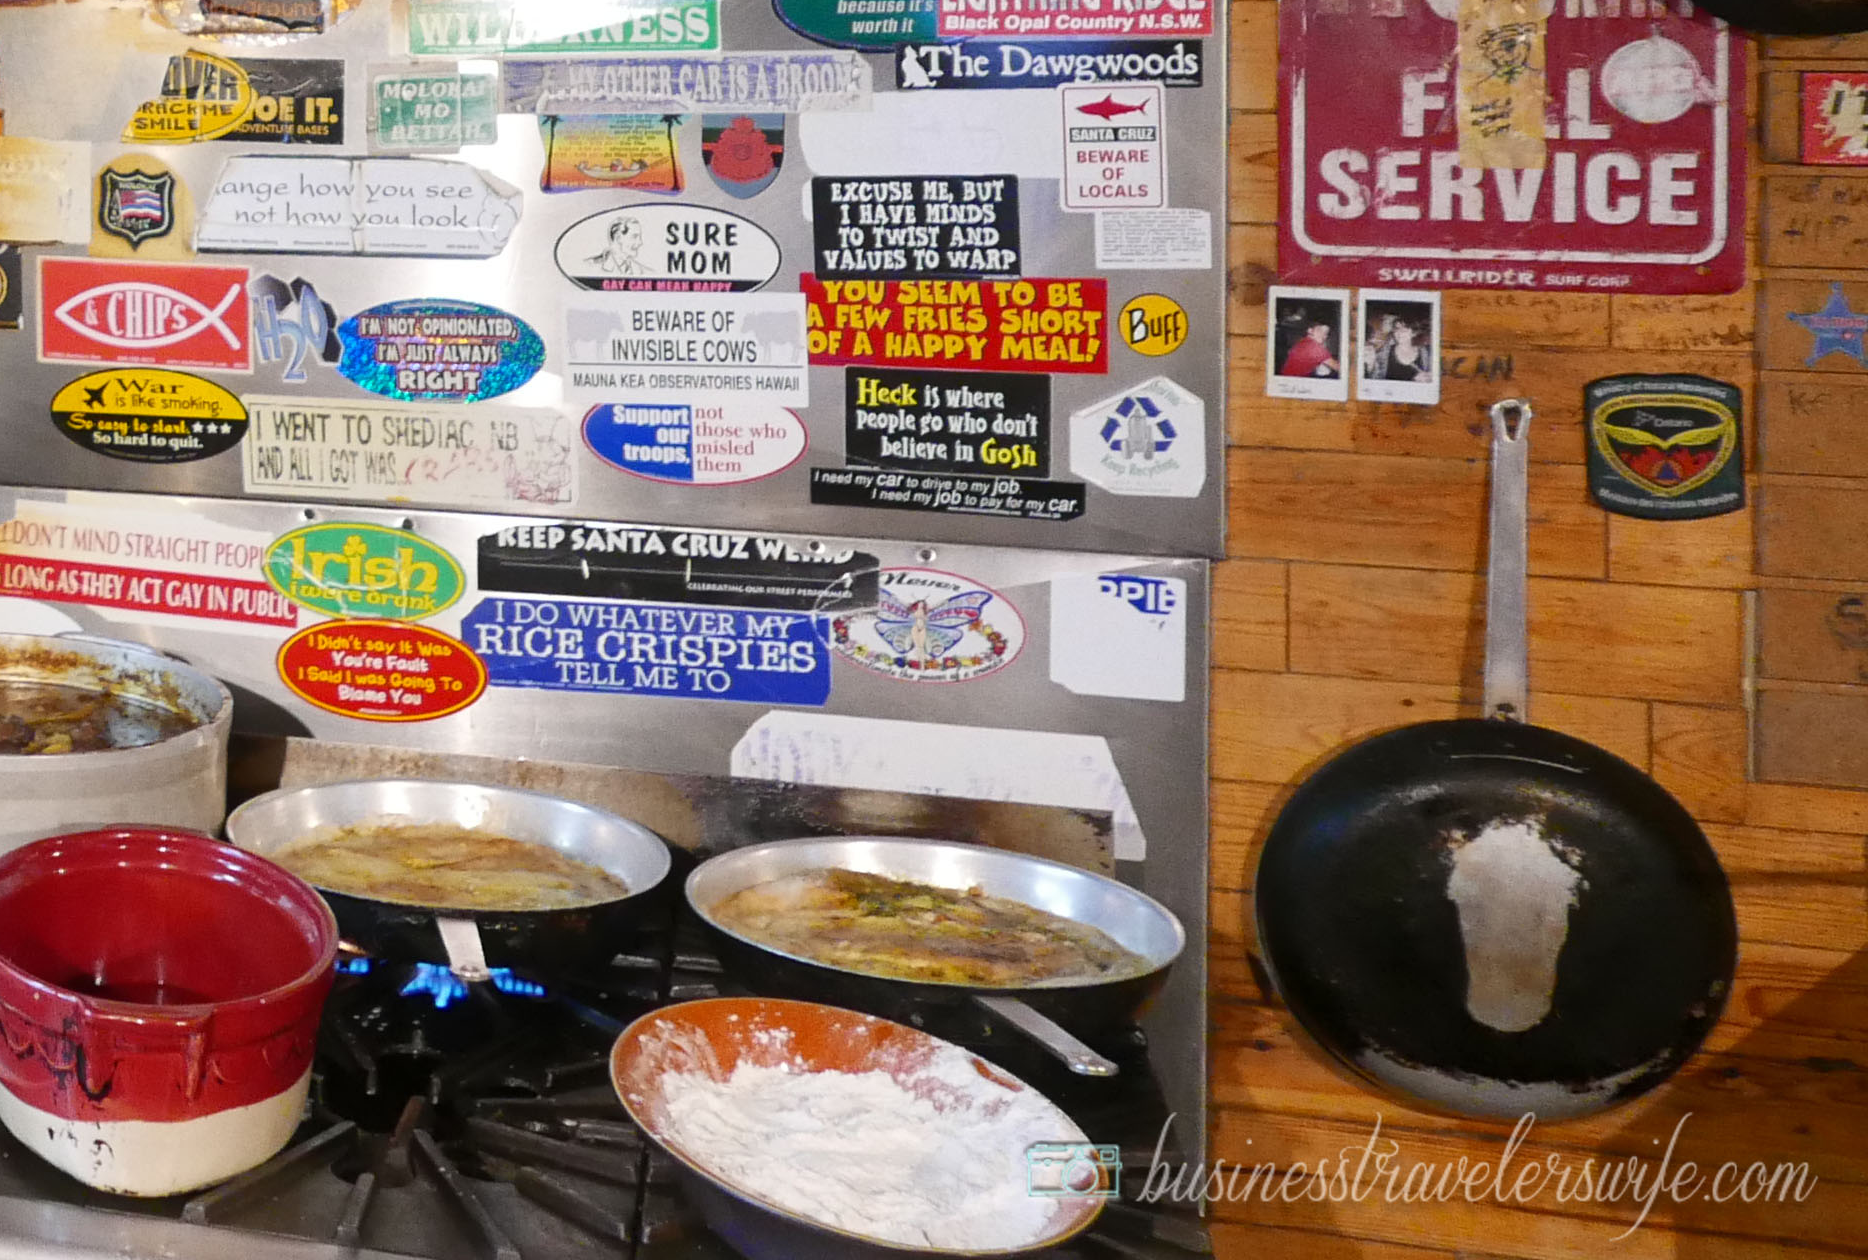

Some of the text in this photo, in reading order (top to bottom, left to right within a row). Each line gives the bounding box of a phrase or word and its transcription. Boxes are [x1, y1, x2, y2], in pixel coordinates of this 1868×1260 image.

[946, 14, 1203, 32] Black Opal Country N.S.W.
[925, 43, 1199, 84] The Dawgwoods
[1071, 127, 1155, 141] SANTA CRUZ
[1077, 150, 1150, 164] BEWARE
[1101, 167, 1125, 181] OF
[1318, 148, 1701, 226] SERVICE
[299, 173, 474, 207] how you see
[1079, 184, 1150, 199] LOCALS
[234, 203, 469, 232] not how you look
[666, 222, 739, 246] SURE
[667, 251, 732, 275] MOM
[821, 280, 1083, 307] YOU SEEM TO BE
[632, 310, 735, 332] BEWARE OF
[836, 305, 1103, 336] FEW FRIES SHORT
[612, 339, 757, 363] INVISIBLE COWS
[808, 331, 1100, 364] OF HAPPY MEAL!
[290, 533, 439, 593] Irish
[567, 605, 737, 637] WHATEVER
[475, 625, 817, 673] RICE CRISPIES
